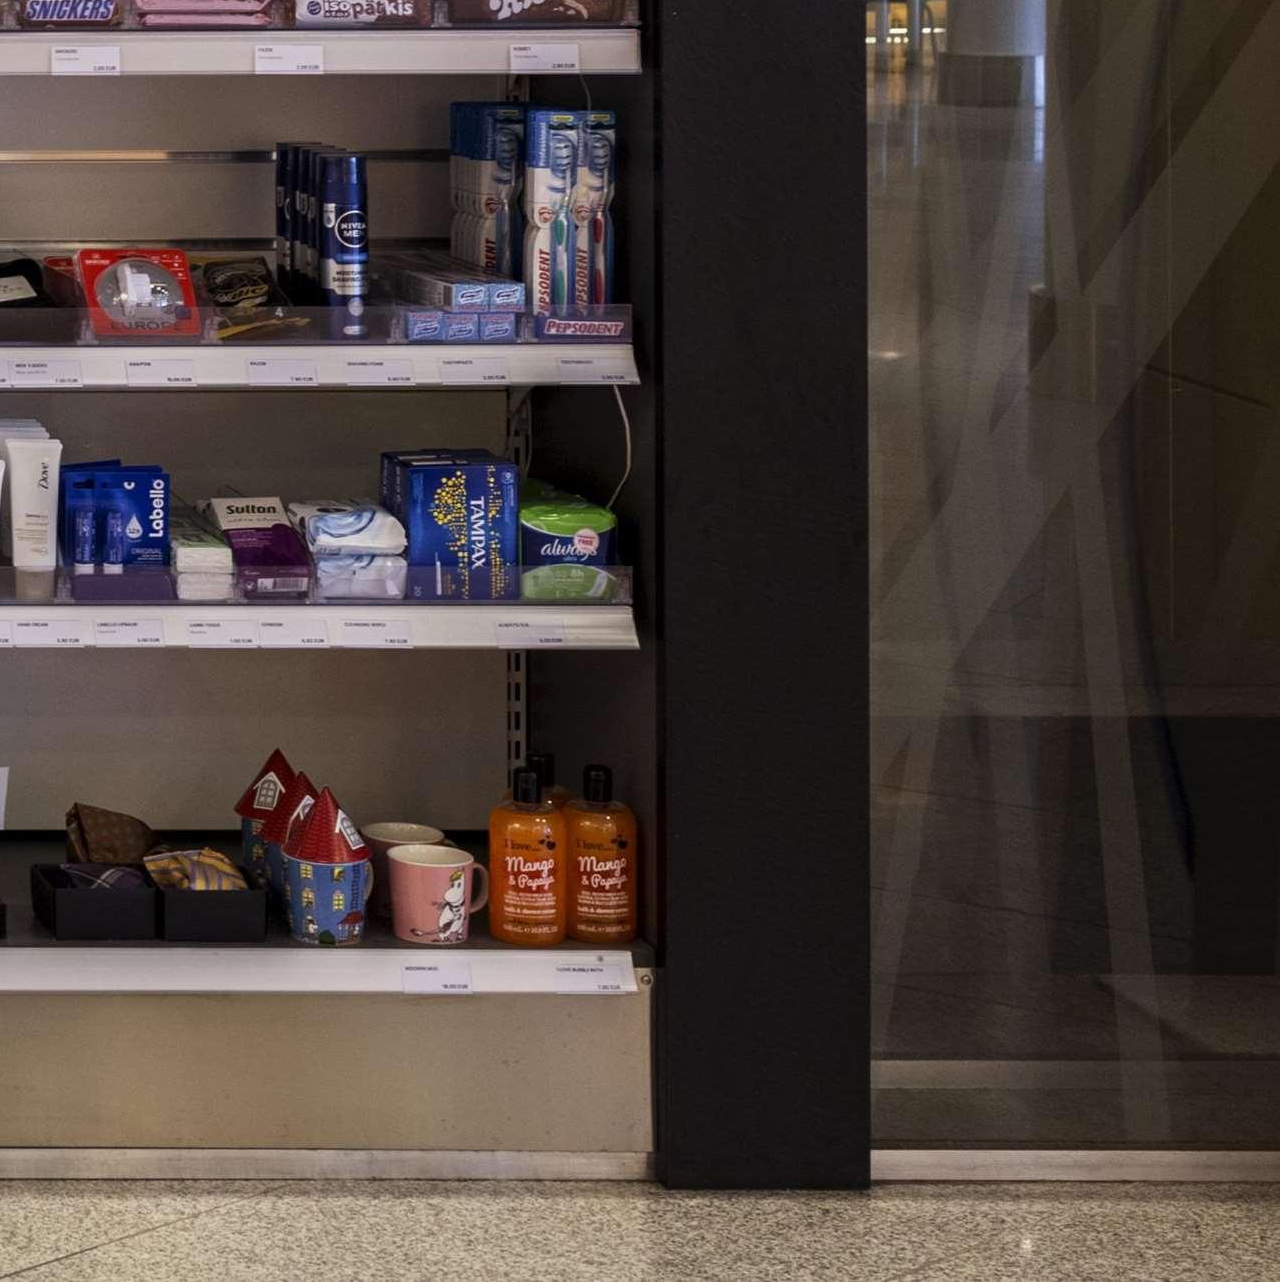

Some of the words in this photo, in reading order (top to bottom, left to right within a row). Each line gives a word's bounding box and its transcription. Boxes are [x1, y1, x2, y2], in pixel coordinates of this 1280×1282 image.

[341, 222, 367, 230] NIVEA
[545, 320, 625, 335] PEPSODENT
[37, 461, 49, 490] Dove
[149, 478, 165, 538] Labello
[226, 504, 278, 516] Sultan
[470, 495, 486, 570] TAMPAX
[541, 538, 598, 562] always
[505, 856, 555, 878] Mango
[577, 856, 627, 877] Mango
[518, 874, 555, 890] Papaya
